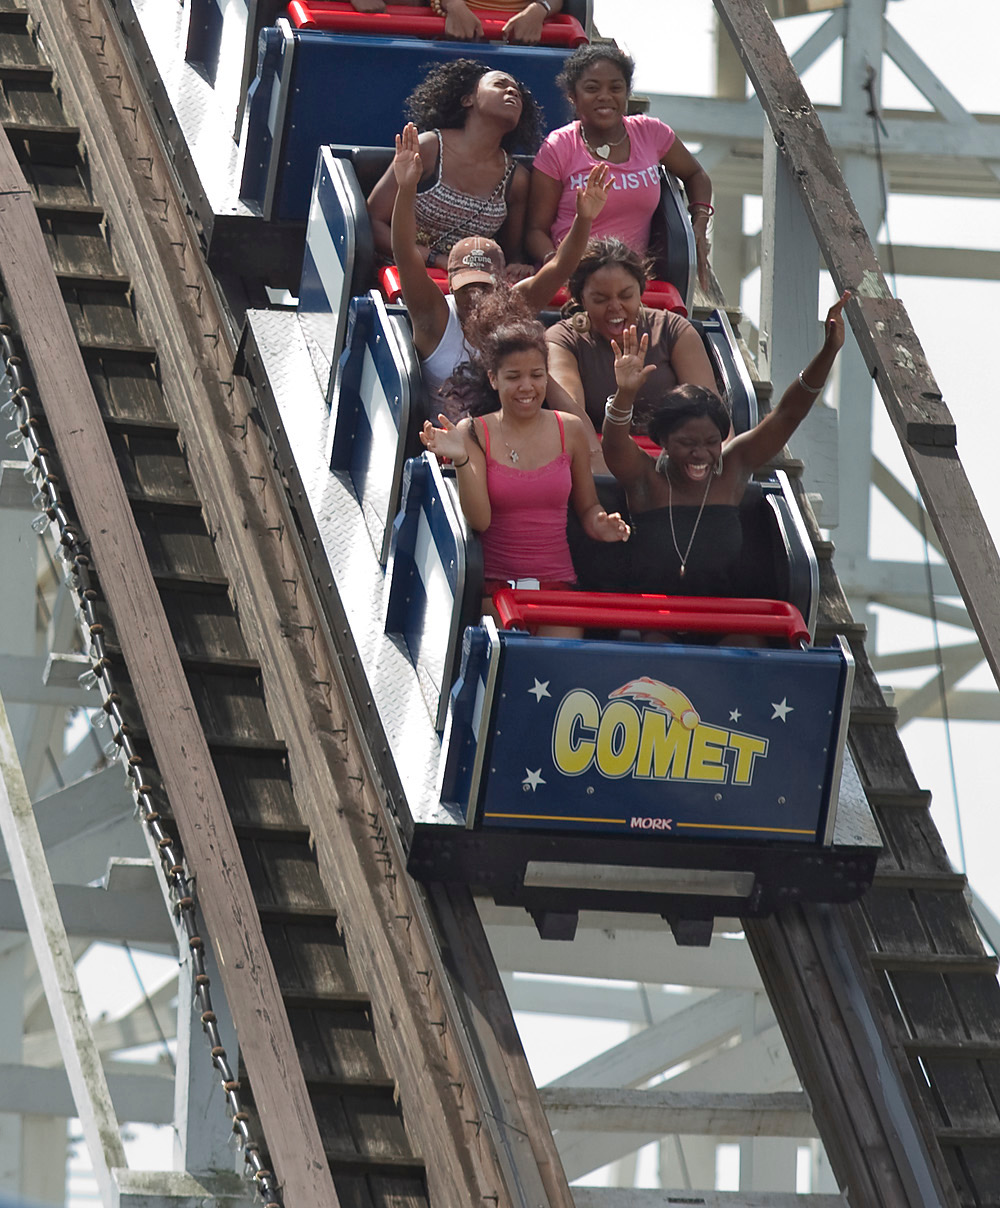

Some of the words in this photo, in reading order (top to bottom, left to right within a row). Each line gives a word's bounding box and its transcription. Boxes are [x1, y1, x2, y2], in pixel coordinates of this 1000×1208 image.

[570, 164, 661, 191] HLISTER
[462, 254, 493, 265] Corona
[551, 688, 769, 786] COMET
[630, 817, 673, 831] MORK
